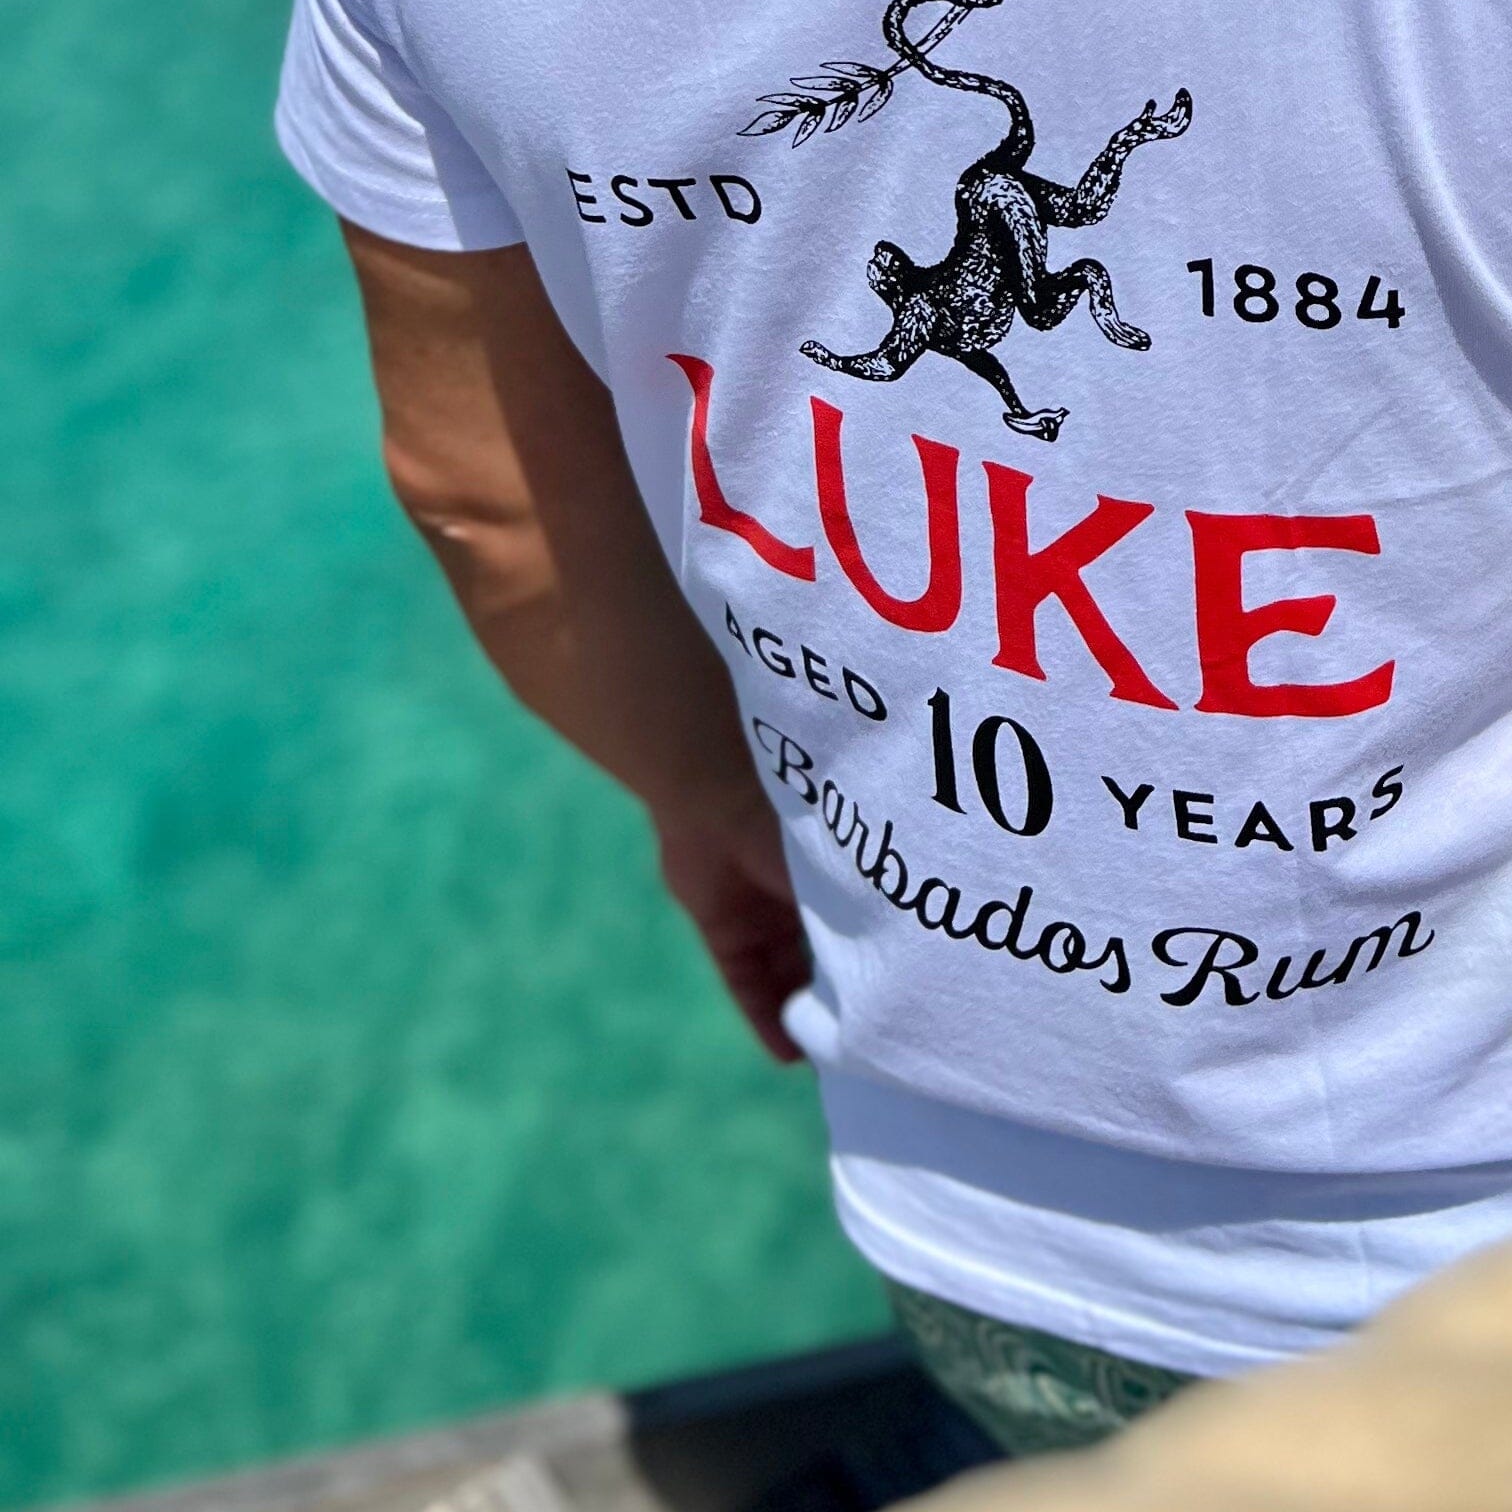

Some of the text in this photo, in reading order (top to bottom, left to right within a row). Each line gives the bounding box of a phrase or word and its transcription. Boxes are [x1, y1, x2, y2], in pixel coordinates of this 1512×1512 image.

[567, 168, 1407, 330] ESTD 1884
[665, 354, 1394, 717] LUKE
[725, 603, 1405, 852] AGED 10 YEARS
[753, 716, 1435, 1007] Barbados Rum
